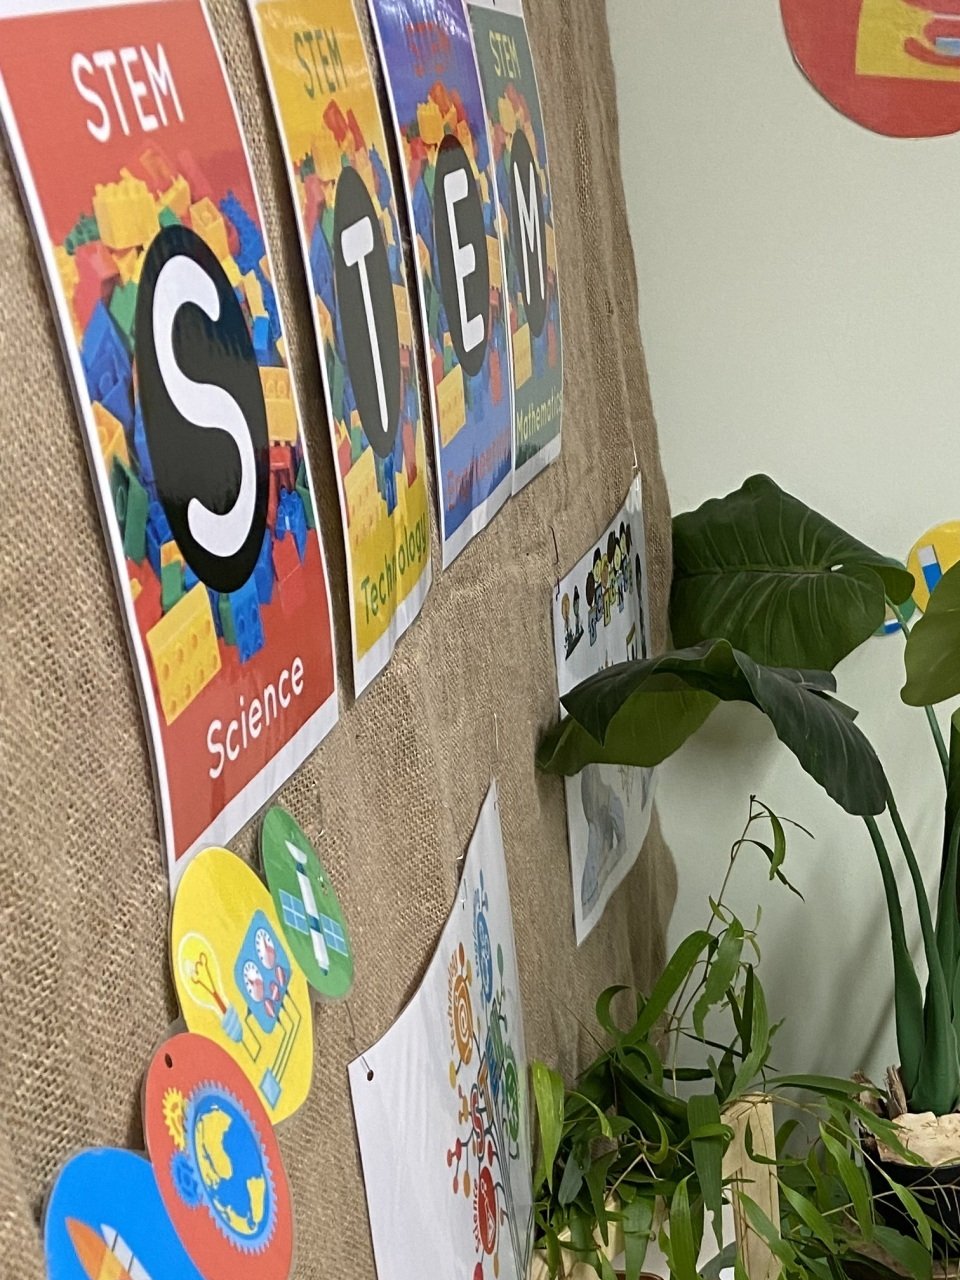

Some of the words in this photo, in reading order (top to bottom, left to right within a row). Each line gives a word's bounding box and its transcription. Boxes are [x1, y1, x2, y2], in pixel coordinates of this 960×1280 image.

[70, 42, 186, 143] STEM
[293, 25, 348, 99] STEM
[488, 29, 521, 79] STEM
[443, 168, 486, 353] E
[513, 161, 546, 306] M
[341, 215, 390, 433] T
[152, 254, 256, 558] S
[361, 511, 427, 625] Technology
[207, 656, 304, 779] Science
